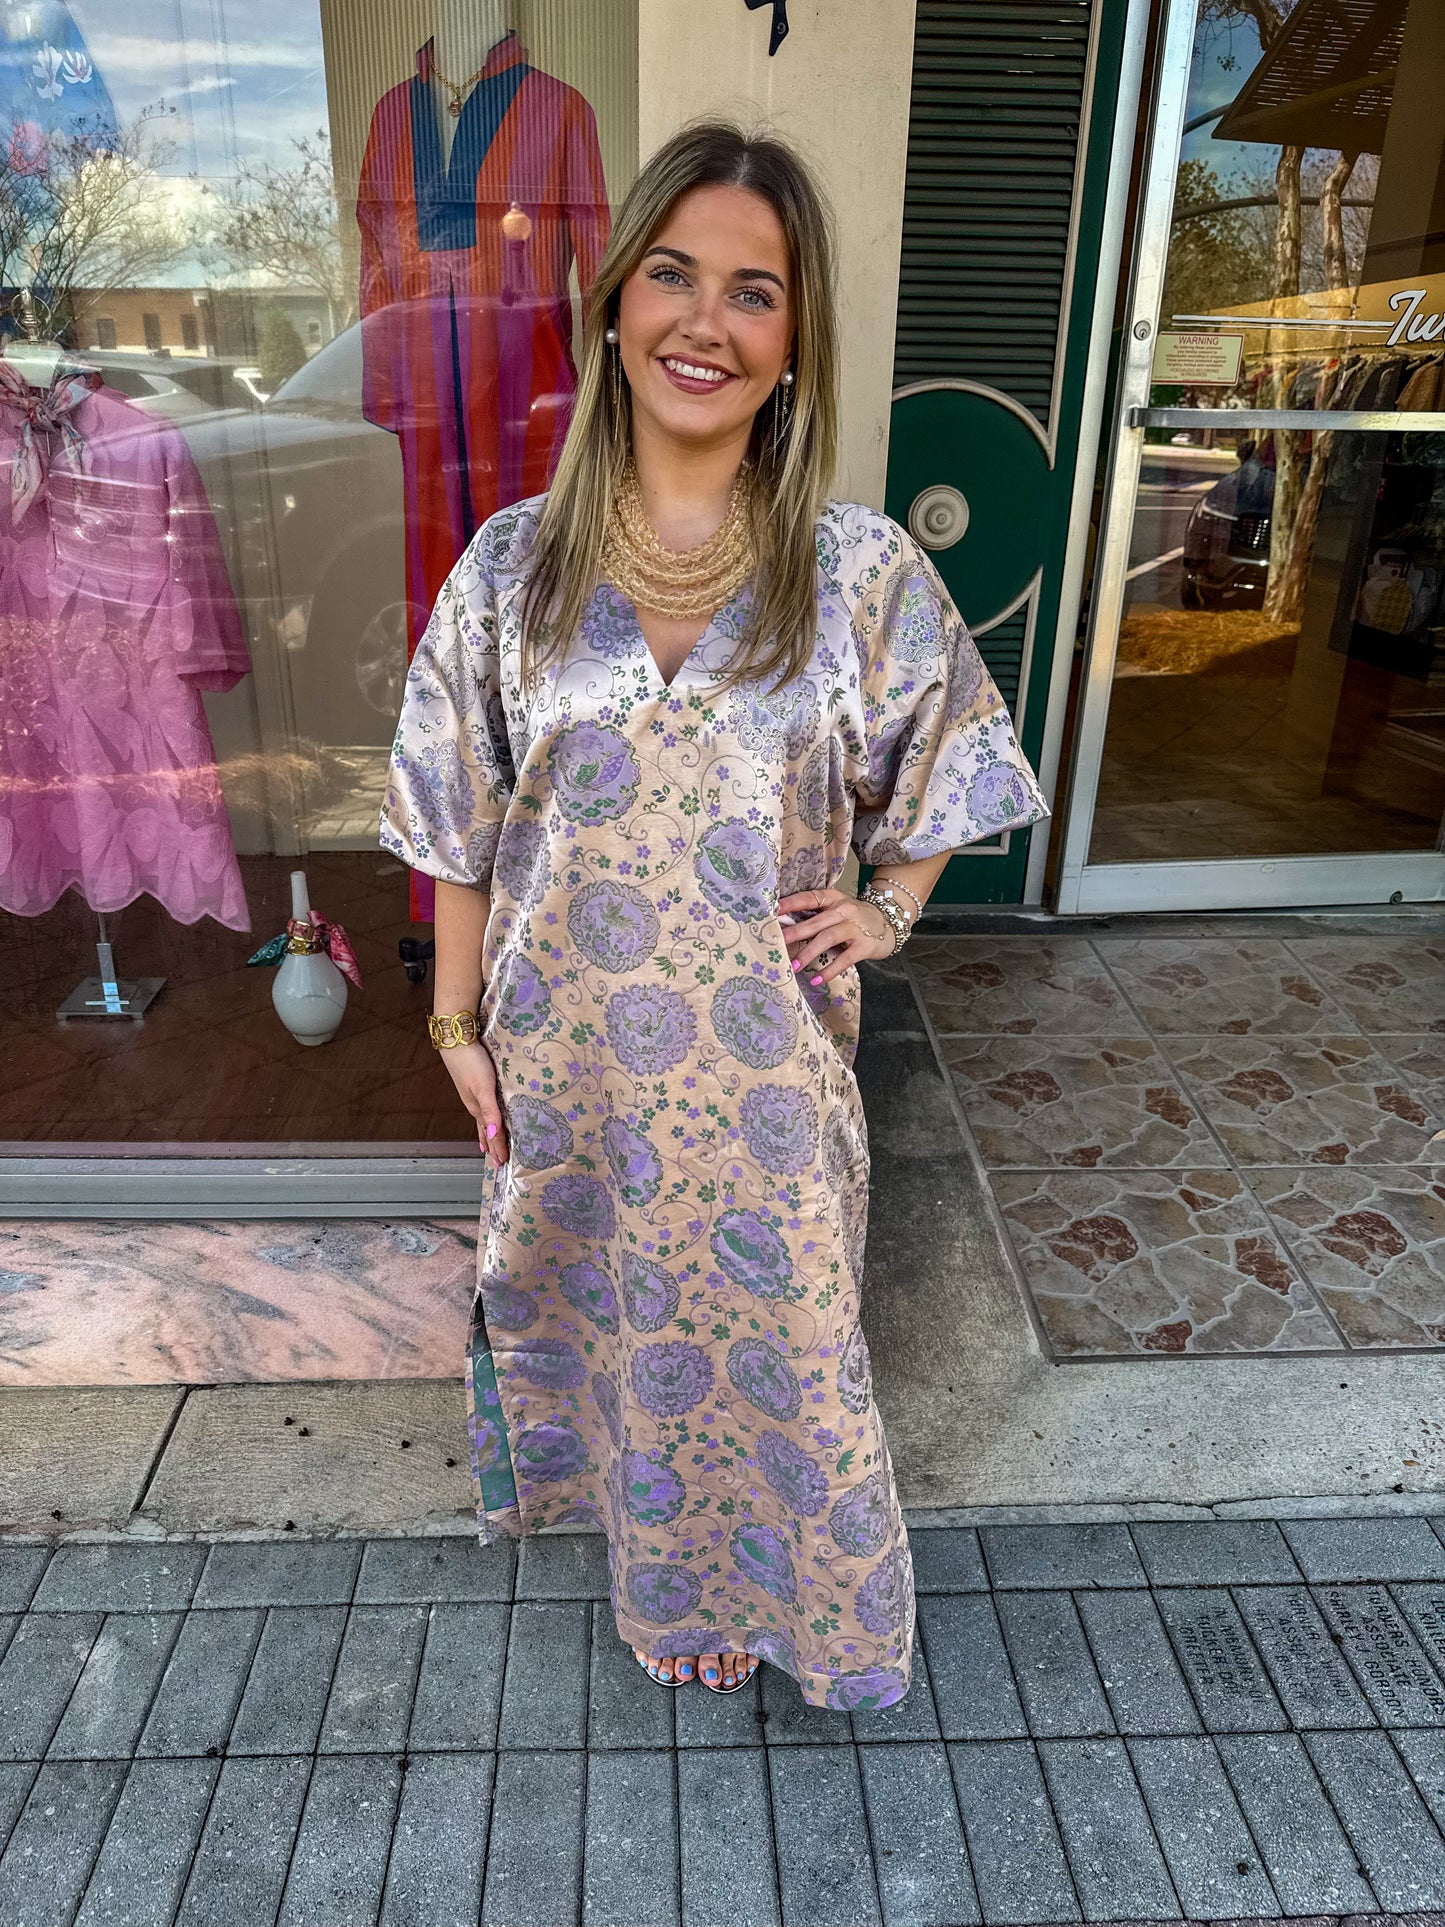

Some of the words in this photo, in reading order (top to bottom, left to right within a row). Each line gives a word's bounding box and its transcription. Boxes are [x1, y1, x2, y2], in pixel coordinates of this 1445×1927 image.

[1179, 337, 1219, 345] WARNING
[1385, 289, 1445, 348] Tw
[1359, 1617, 1412, 1687] ASSOCIATE
